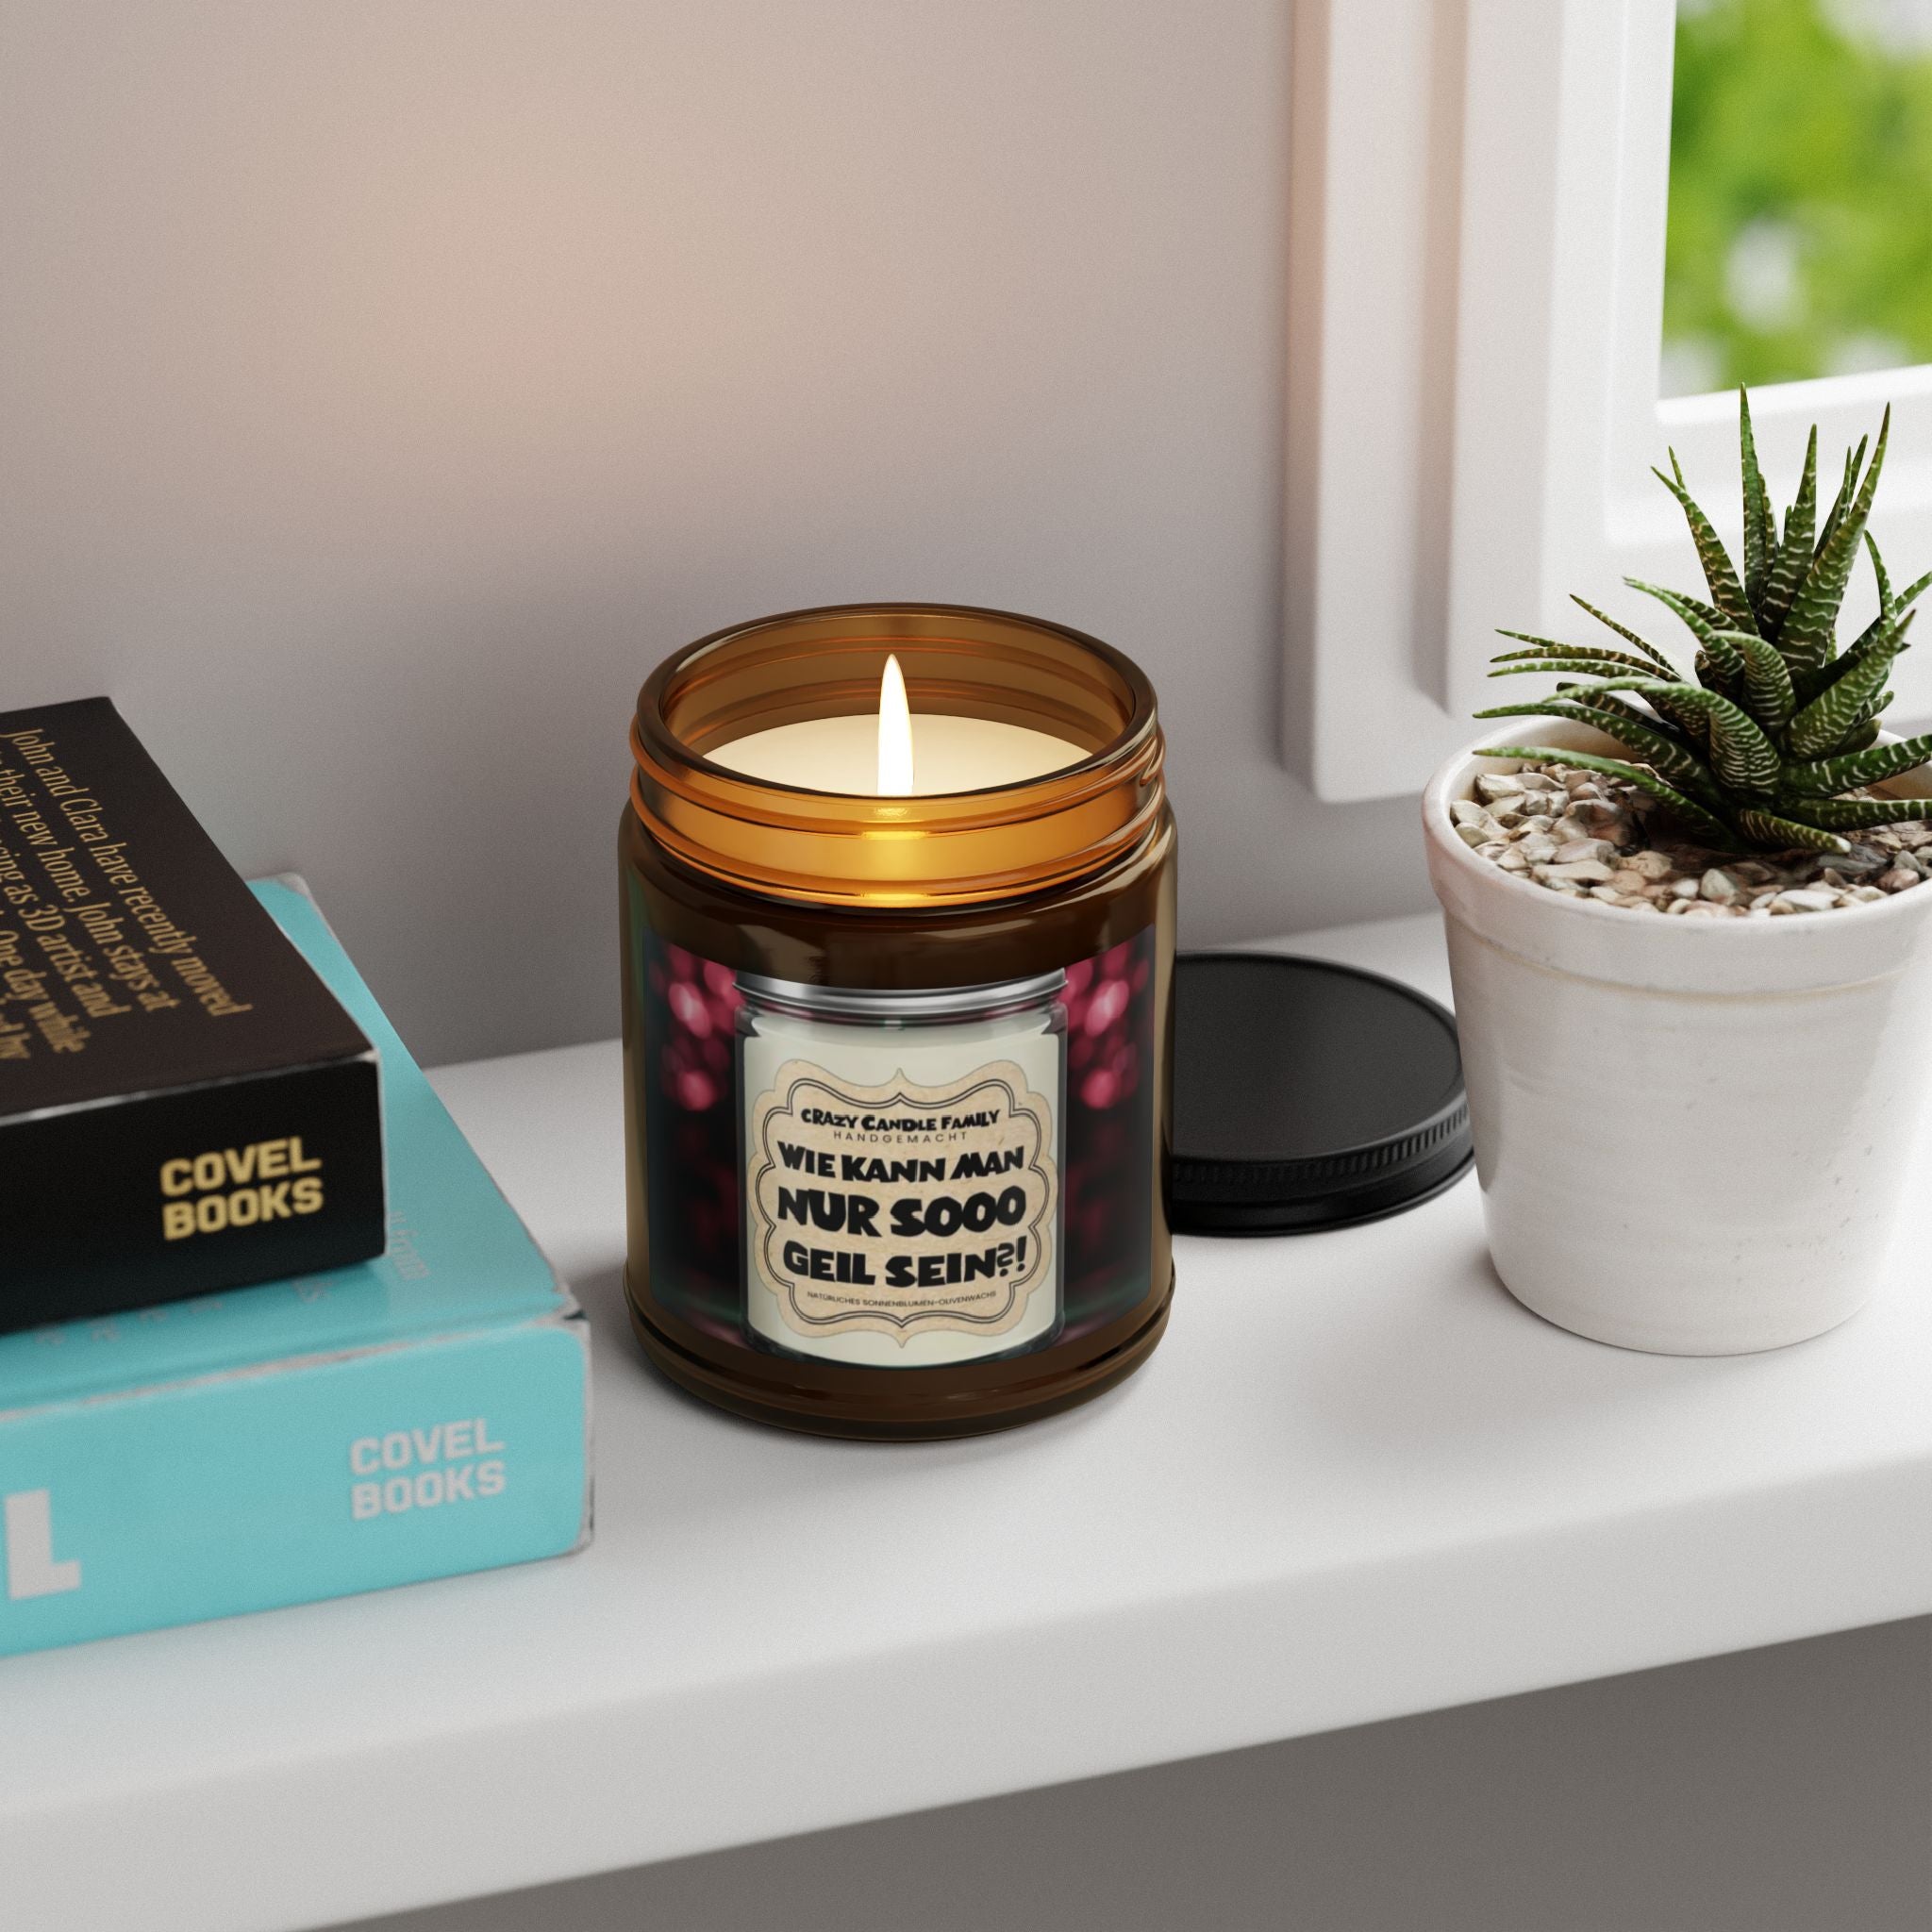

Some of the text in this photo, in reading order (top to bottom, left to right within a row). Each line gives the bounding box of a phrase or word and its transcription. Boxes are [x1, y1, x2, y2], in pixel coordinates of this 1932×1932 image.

[12, 811, 58, 845] new
[0, 729, 252, 1016] John and Clara have recently moved
[4, 885, 38, 904] as
[38, 847, 91, 902] home.
[19, 906, 65, 930] 3D
[63, 903, 124, 944] John
[37, 934, 97, 982] artist
[104, 945, 160, 991] stays
[72, 984, 131, 1017] and
[138, 991, 179, 1011] at
[801, 1108, 860, 1129] CRAZY
[834, 1129, 967, 1143] HANDGEMACHT
[160, 1136, 323, 1198] COVEL
[774, 1141, 1024, 1183] WIE KANN MAN
[163, 1178, 325, 1241] BOOKS
[776, 1185, 1027, 1238] NUR SOOO
[782, 1236, 1028, 1289] GEIL SEIN?!
[808, 1291, 860, 1306] NATÜRLICHES
[350, 1418, 506, 1476] COVEL
[352, 1459, 506, 1522] BOOKS
